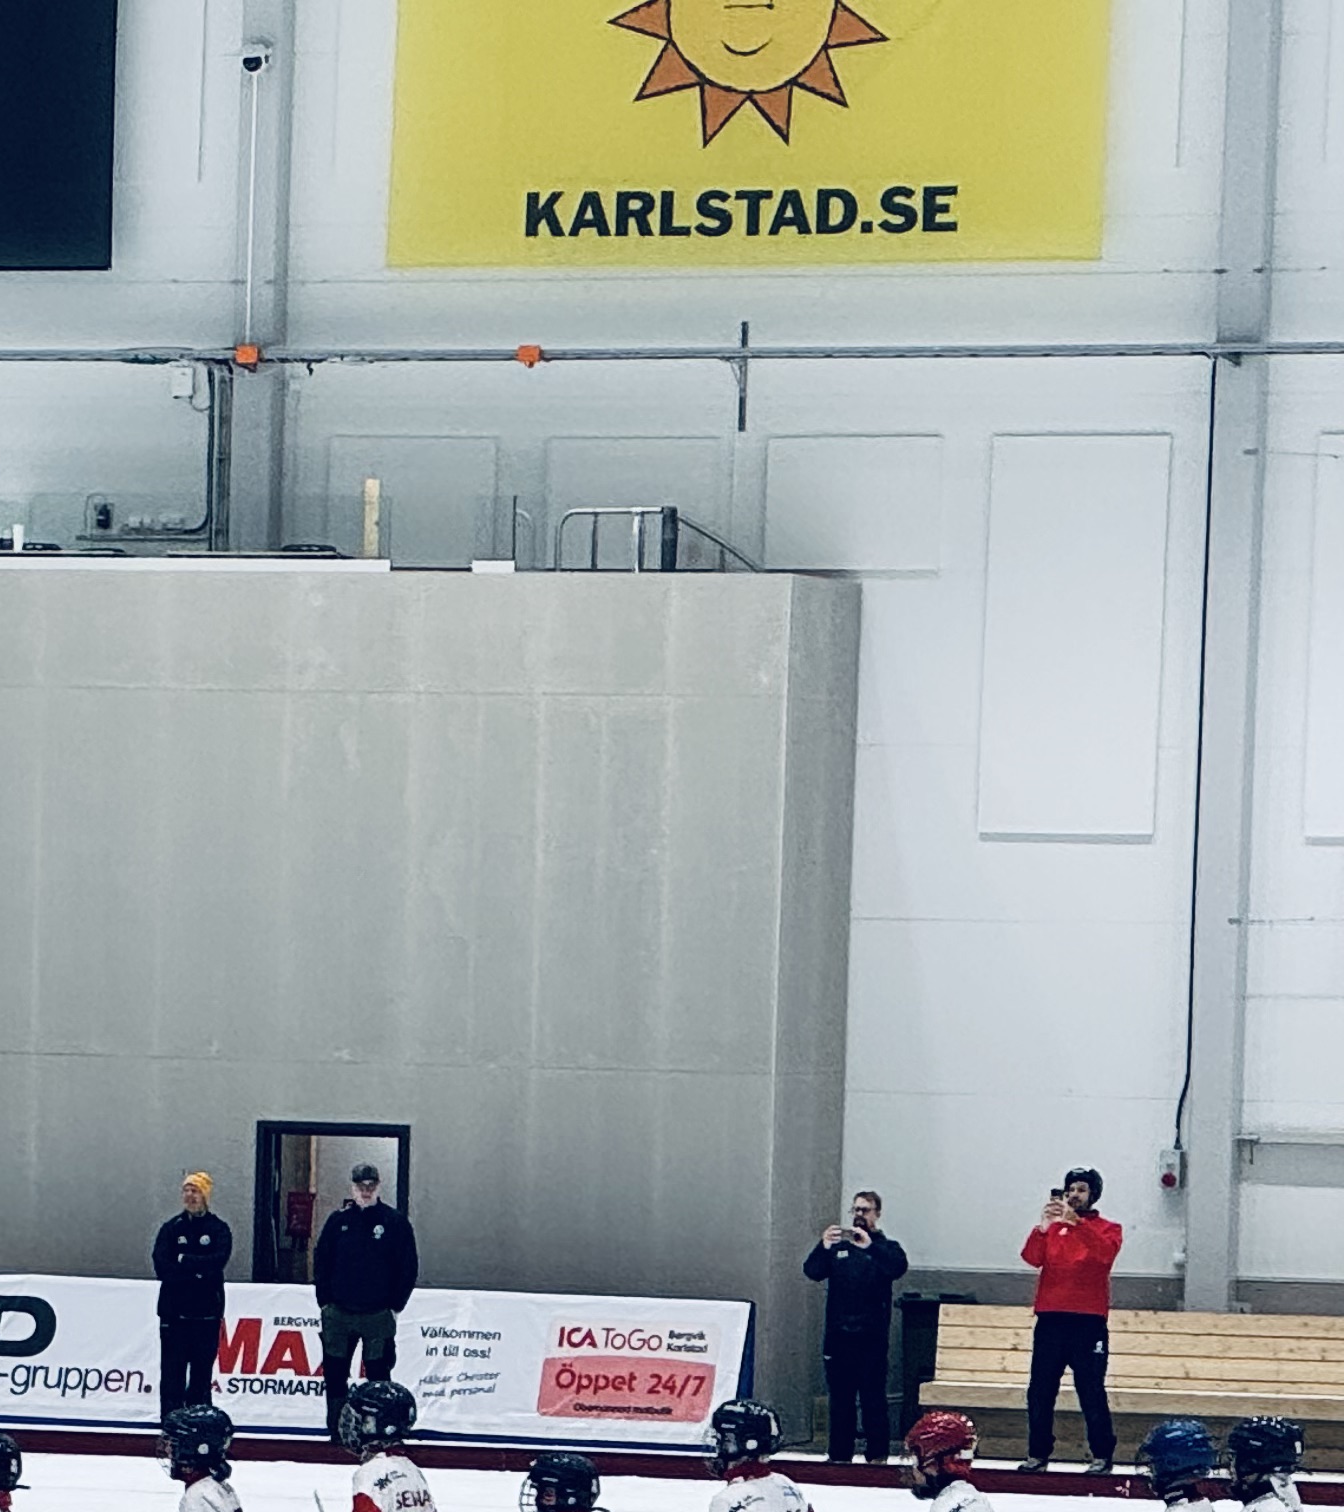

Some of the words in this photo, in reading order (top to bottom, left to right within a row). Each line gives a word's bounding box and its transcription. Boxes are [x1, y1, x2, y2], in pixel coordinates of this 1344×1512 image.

[524, 186, 959, 238] KARLSTAD.SE
[420, 1326, 502, 1341] Välkommen
[558, 1326, 598, 1348] ICA
[555, 1363, 637, 1395] Öppet
[647, 1373, 706, 1399] 24/7
